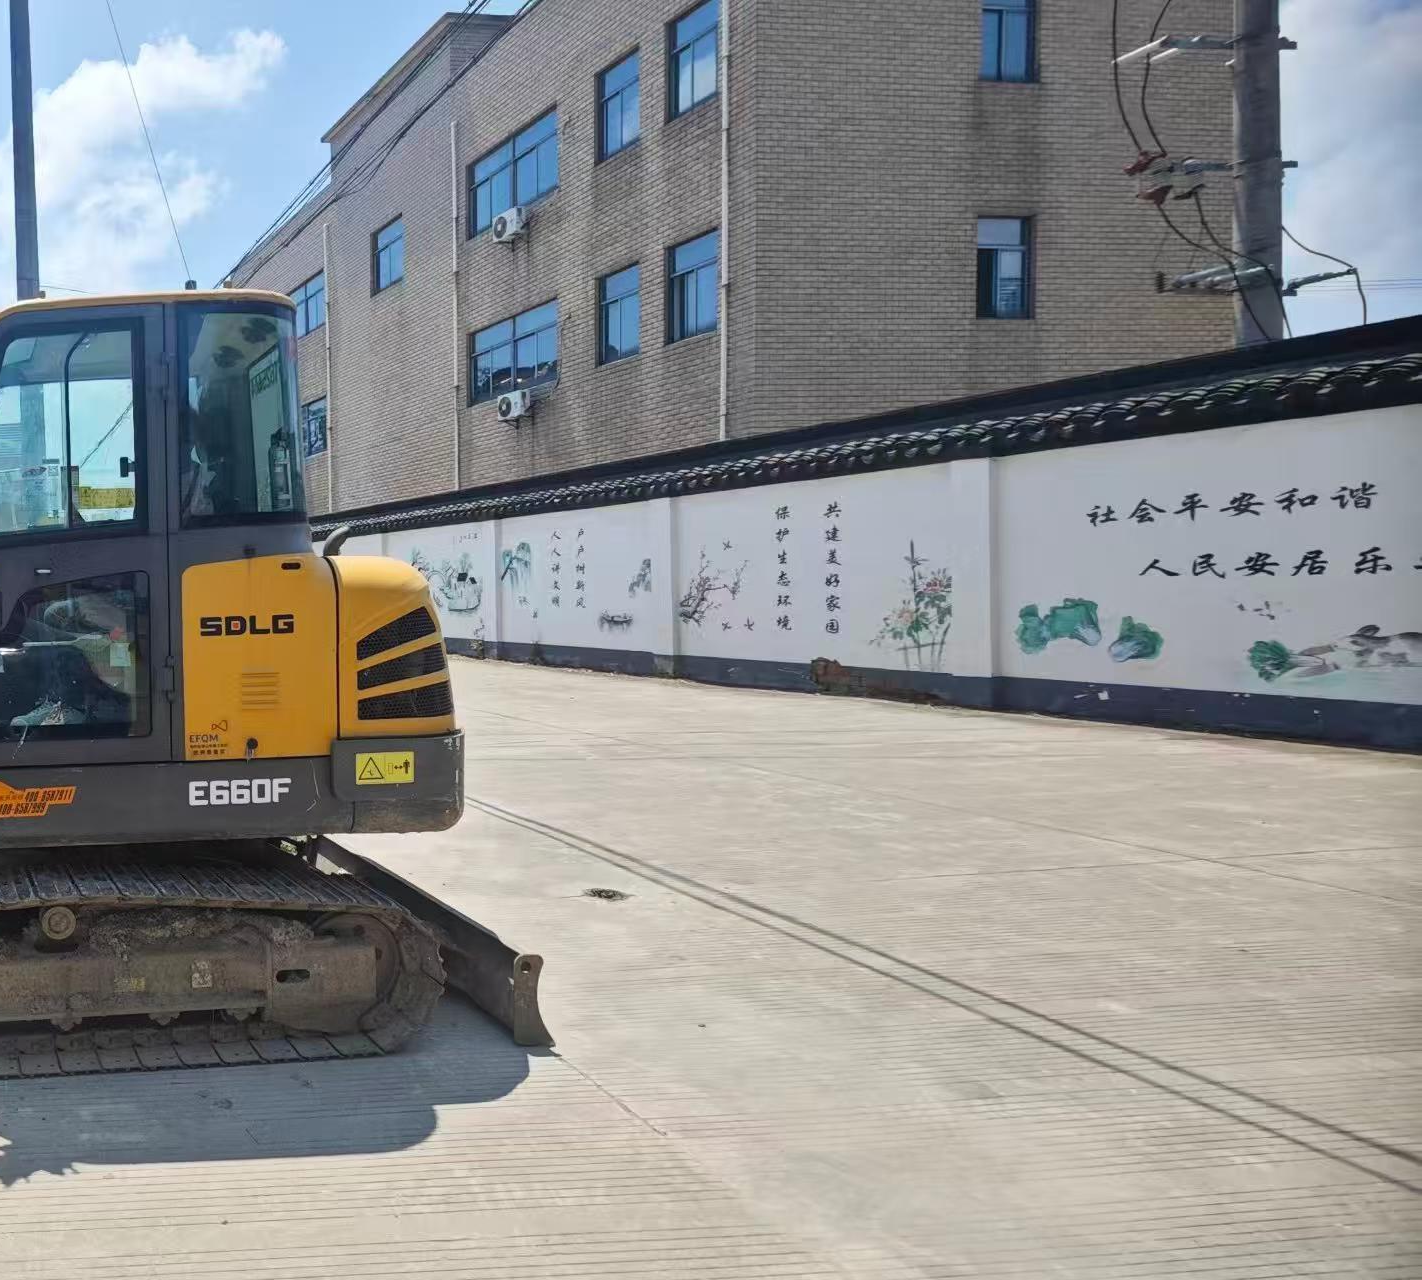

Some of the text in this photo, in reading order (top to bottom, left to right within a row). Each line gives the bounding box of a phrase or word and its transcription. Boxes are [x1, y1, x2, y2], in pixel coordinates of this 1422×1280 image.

[1086, 481, 1377, 527] 社会平安和谐
[775, 506, 792, 631] 保护生态环境
[1138, 546, 1422, 579] 人民安居乐
[200, 614, 294, 636] SDLG
[189, 734, 219, 743] EFQM
[189, 778, 292, 806] E660F
